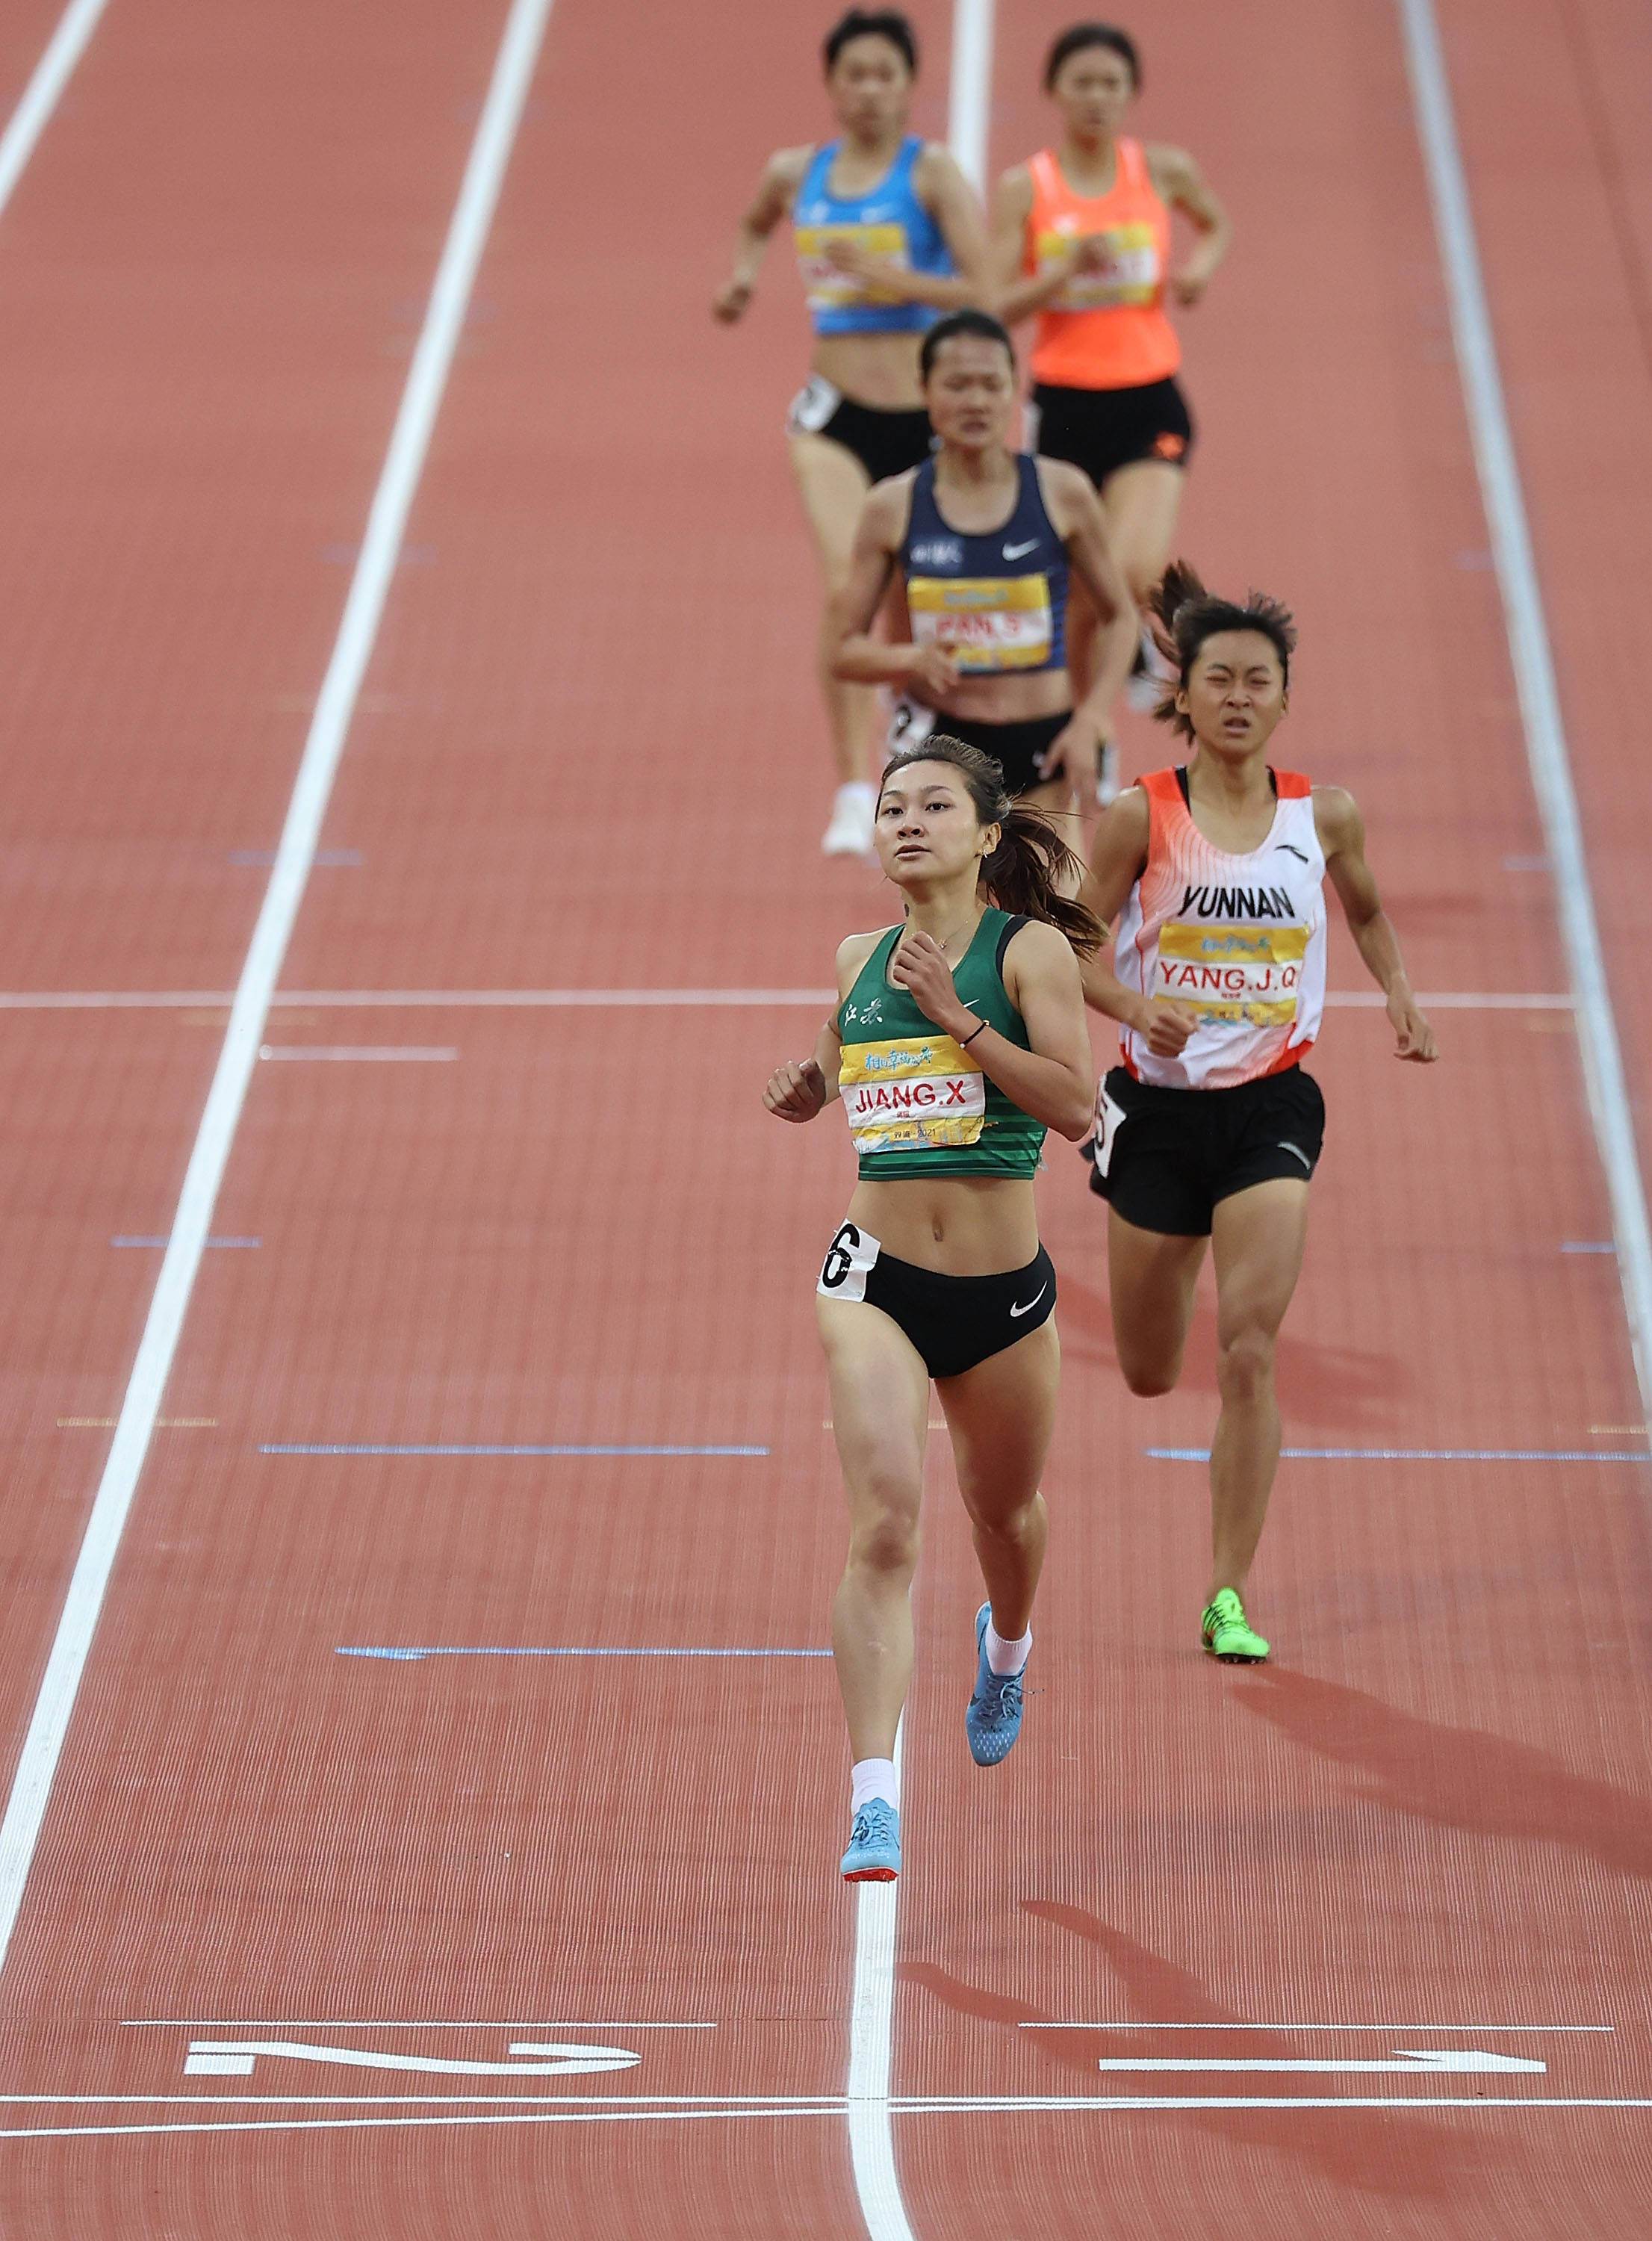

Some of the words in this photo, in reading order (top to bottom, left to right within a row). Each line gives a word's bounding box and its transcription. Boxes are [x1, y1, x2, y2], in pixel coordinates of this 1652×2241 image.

[1177, 885, 1296, 919] YUNNAN
[1160, 961, 1297, 992] YANG.J.Q
[855, 1080, 966, 1114] JIANG.X
[822, 1223, 860, 1289] 6
